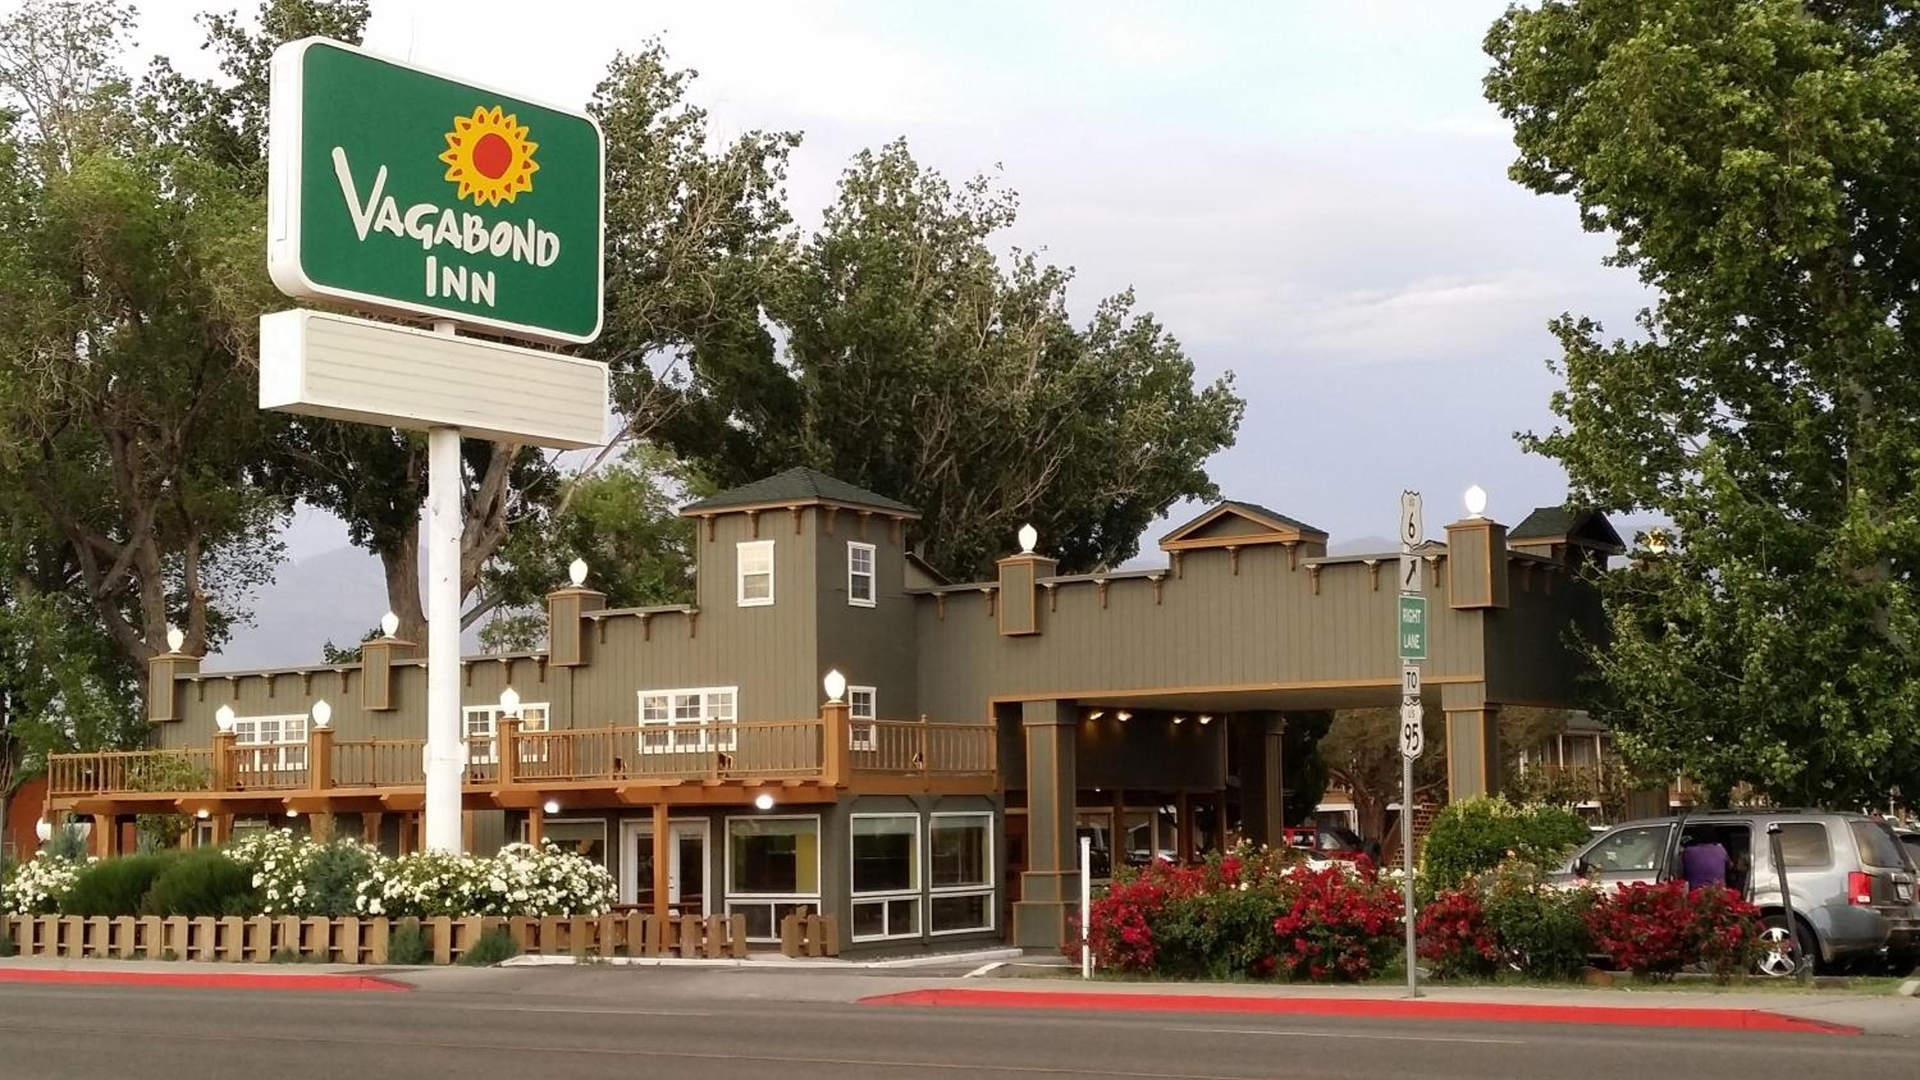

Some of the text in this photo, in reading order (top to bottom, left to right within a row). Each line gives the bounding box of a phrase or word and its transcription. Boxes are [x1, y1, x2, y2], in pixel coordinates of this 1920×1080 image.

[331, 146, 560, 267] VAGABOND
[425, 255, 496, 308] INN
[1407, 511, 1416, 539] 6
[1402, 608, 1421, 624] RIGHT
[1403, 634, 1421, 649] LANE
[1406, 671, 1418, 689] TO
[1404, 723, 1419, 751] 95
